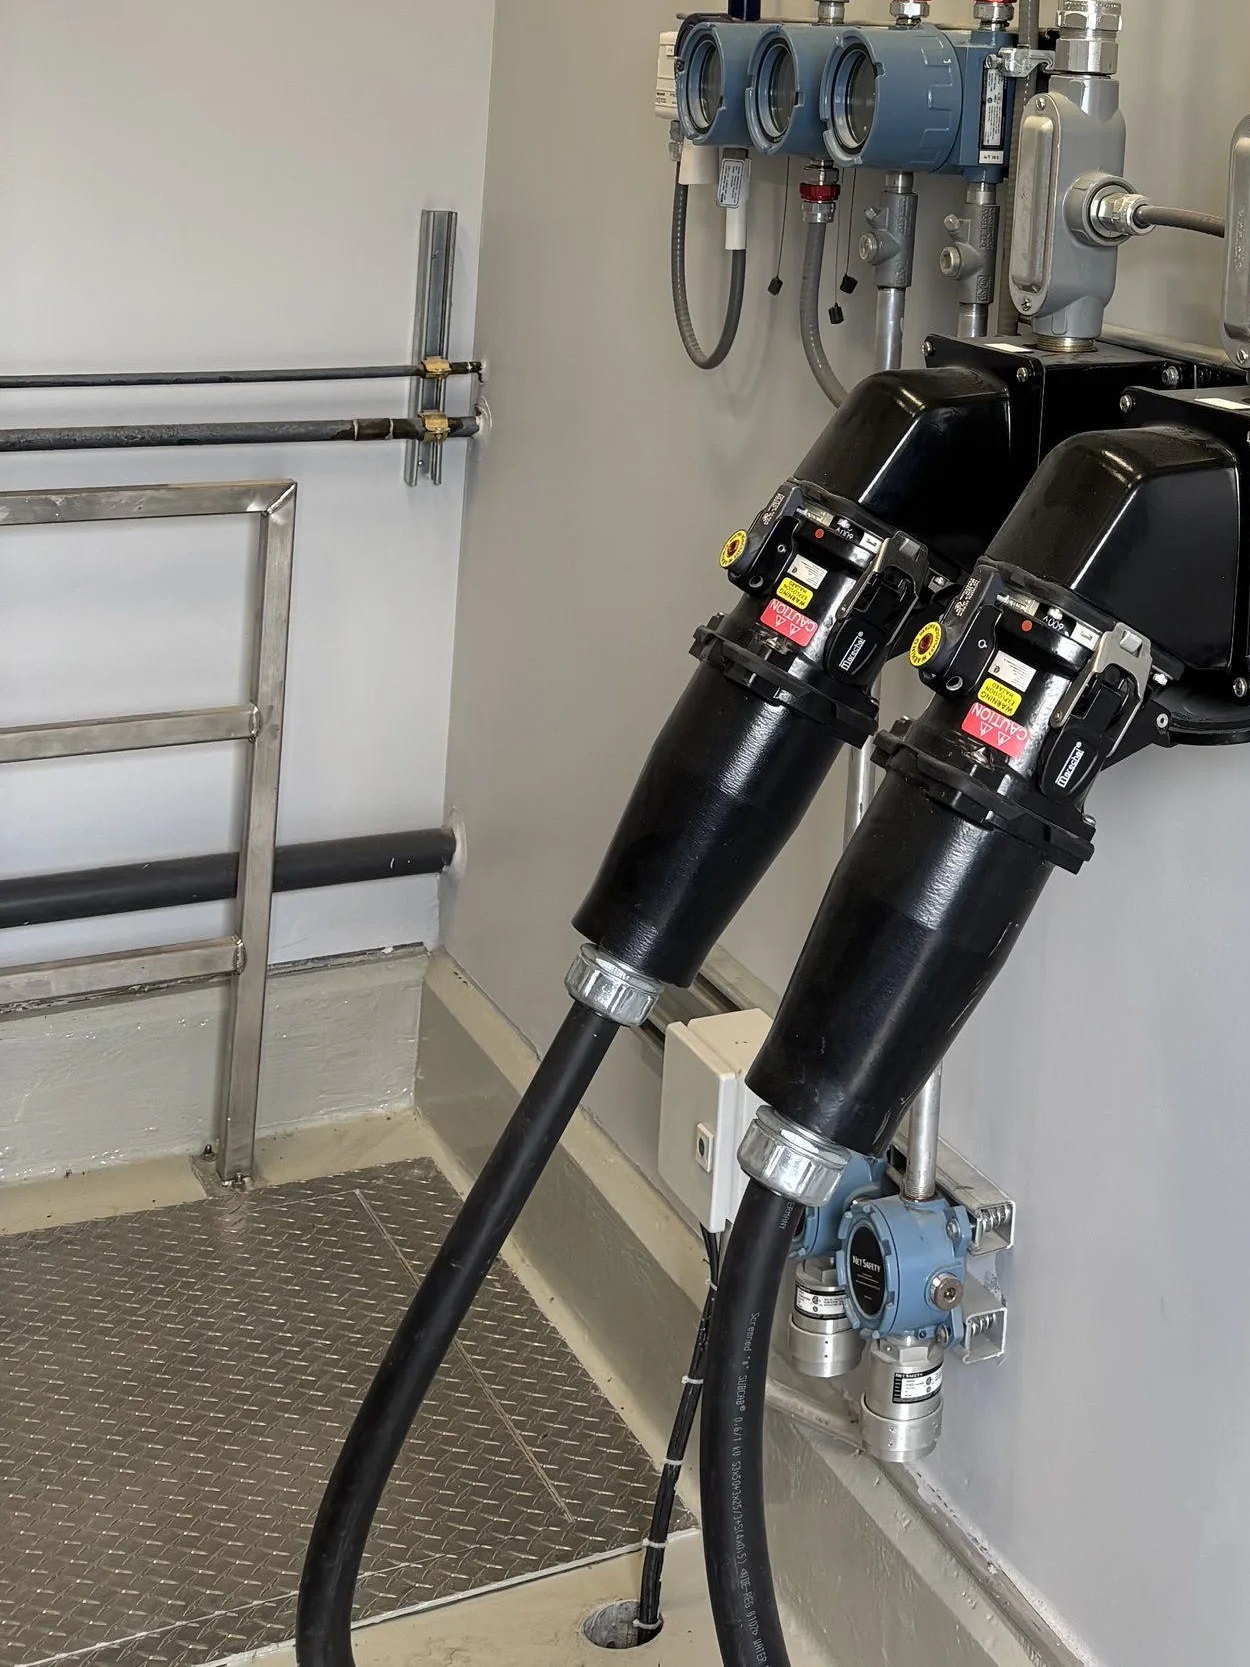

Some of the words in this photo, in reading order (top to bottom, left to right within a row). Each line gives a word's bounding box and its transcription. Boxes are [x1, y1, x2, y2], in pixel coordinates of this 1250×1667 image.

[778, 588, 806, 607] WARNING
[770, 599, 818, 632] CAUTION
[980, 690, 1013, 714] WARNING
[985, 685, 1015, 706] EXPLOSION
[991, 682, 1014, 697] HAZARD
[971, 704, 1027, 741] CAUTION
[779, 1201, 795, 1230] ERMANY
[743, 1312, 760, 1352] Screened
[753, 1637, 767, 1664] WATER
